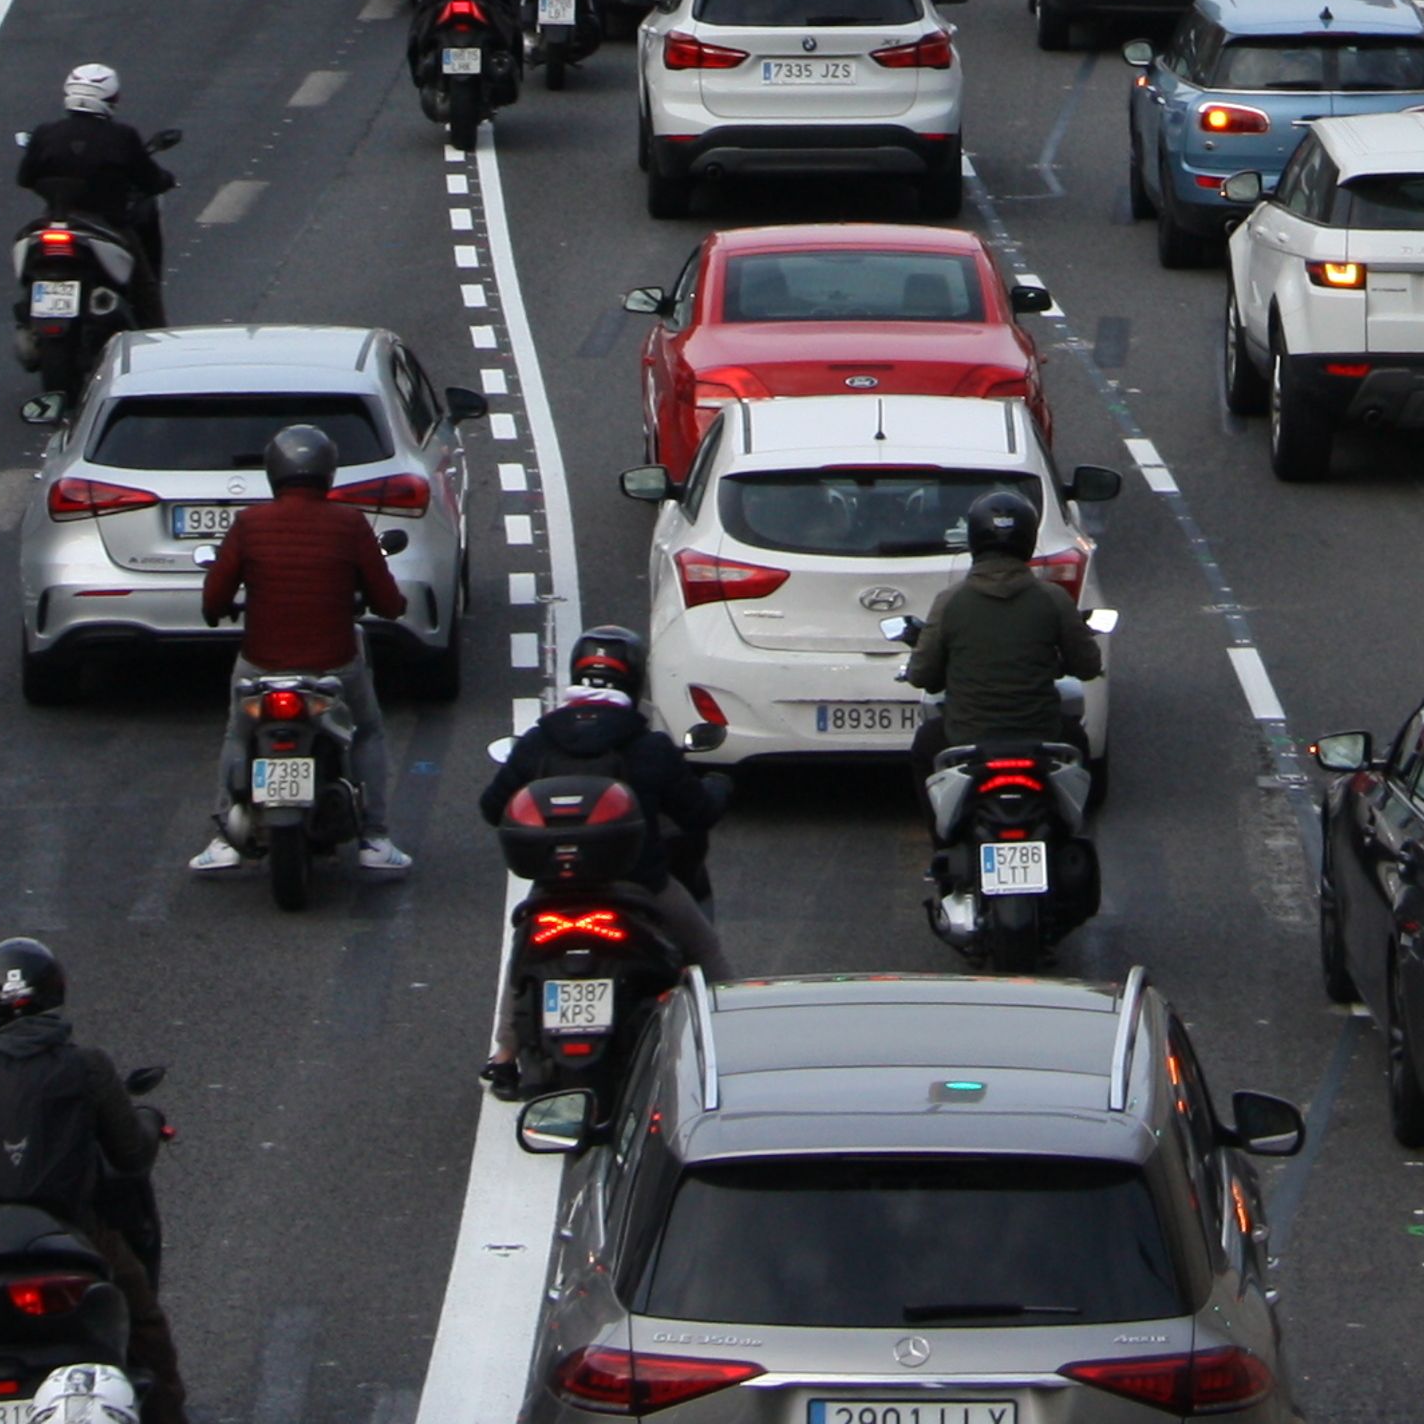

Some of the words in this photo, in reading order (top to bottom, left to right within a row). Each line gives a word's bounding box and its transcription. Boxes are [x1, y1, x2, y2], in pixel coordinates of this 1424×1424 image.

[774, 63, 813, 78] 7335
[821, 63, 851, 78] JZS
[189, 510, 231, 530] 938
[832, 708, 892, 729] 8936
[268, 761, 311, 780] 7383
[267, 780, 300, 798] GFD
[996, 846, 1042, 865] 5786
[997, 865, 1030, 884] LTT
[560, 982, 609, 1003] 5387
[560, 1003, 596, 1024] KPS
[653, 1332, 691, 1343] GLE
[835, 1407, 921, 1424] 2901
